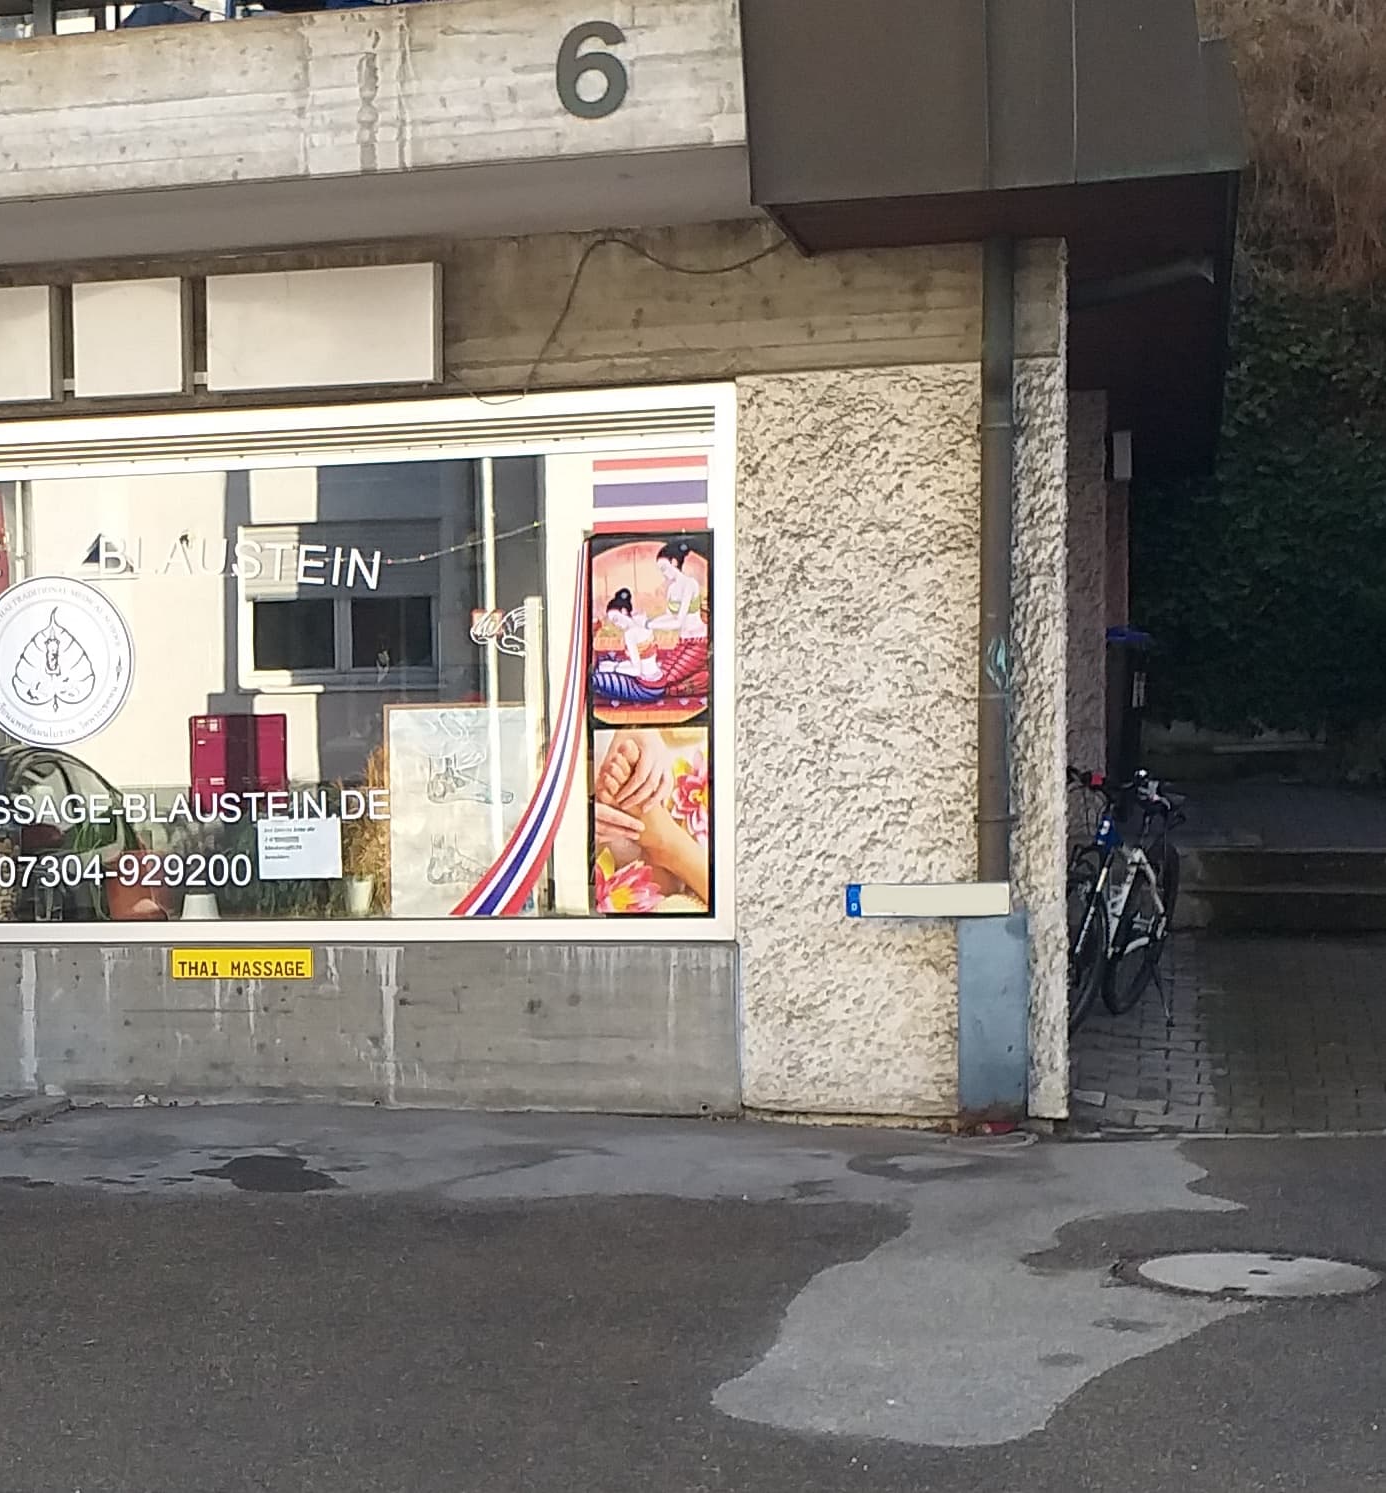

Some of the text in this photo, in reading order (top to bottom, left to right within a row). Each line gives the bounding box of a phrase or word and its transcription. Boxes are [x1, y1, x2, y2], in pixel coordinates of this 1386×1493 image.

[556, 20, 628, 119] 6
[99, 534, 382, 590] BLAUSTEIN
[178, 961, 306, 977] THAI MASSAGE
